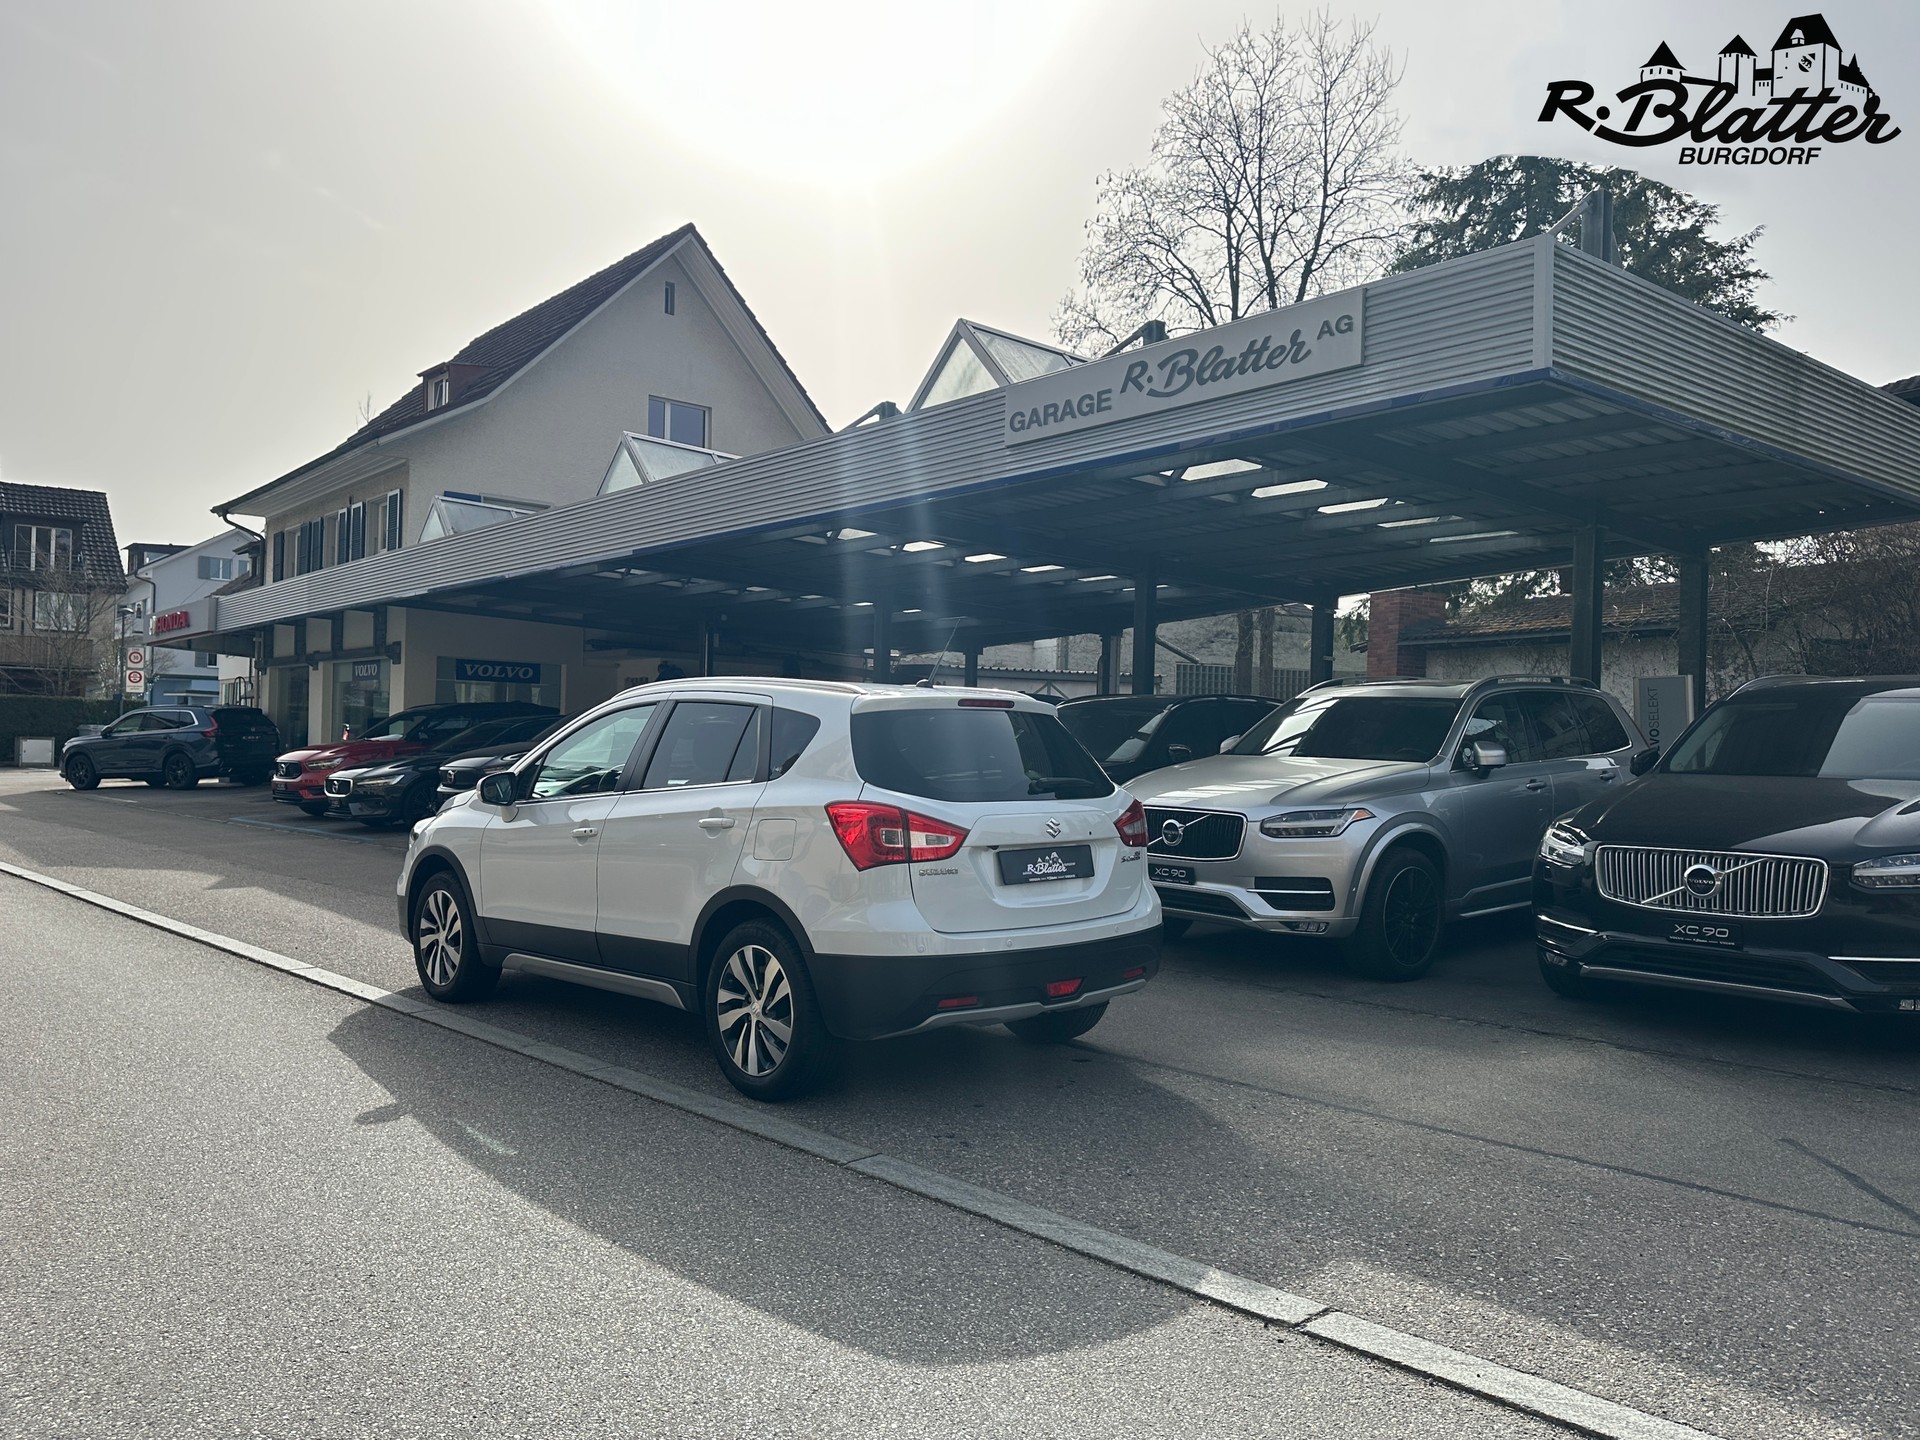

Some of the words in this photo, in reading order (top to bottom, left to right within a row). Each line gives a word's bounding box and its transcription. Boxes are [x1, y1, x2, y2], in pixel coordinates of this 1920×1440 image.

[1009, 388, 1113, 433] GARAGE
[1316, 314, 1354, 341] AG
[154, 611, 190, 633] HONDA
[354, 663, 377, 677] VOLVO
[464, 663, 533, 679] VOLVO
